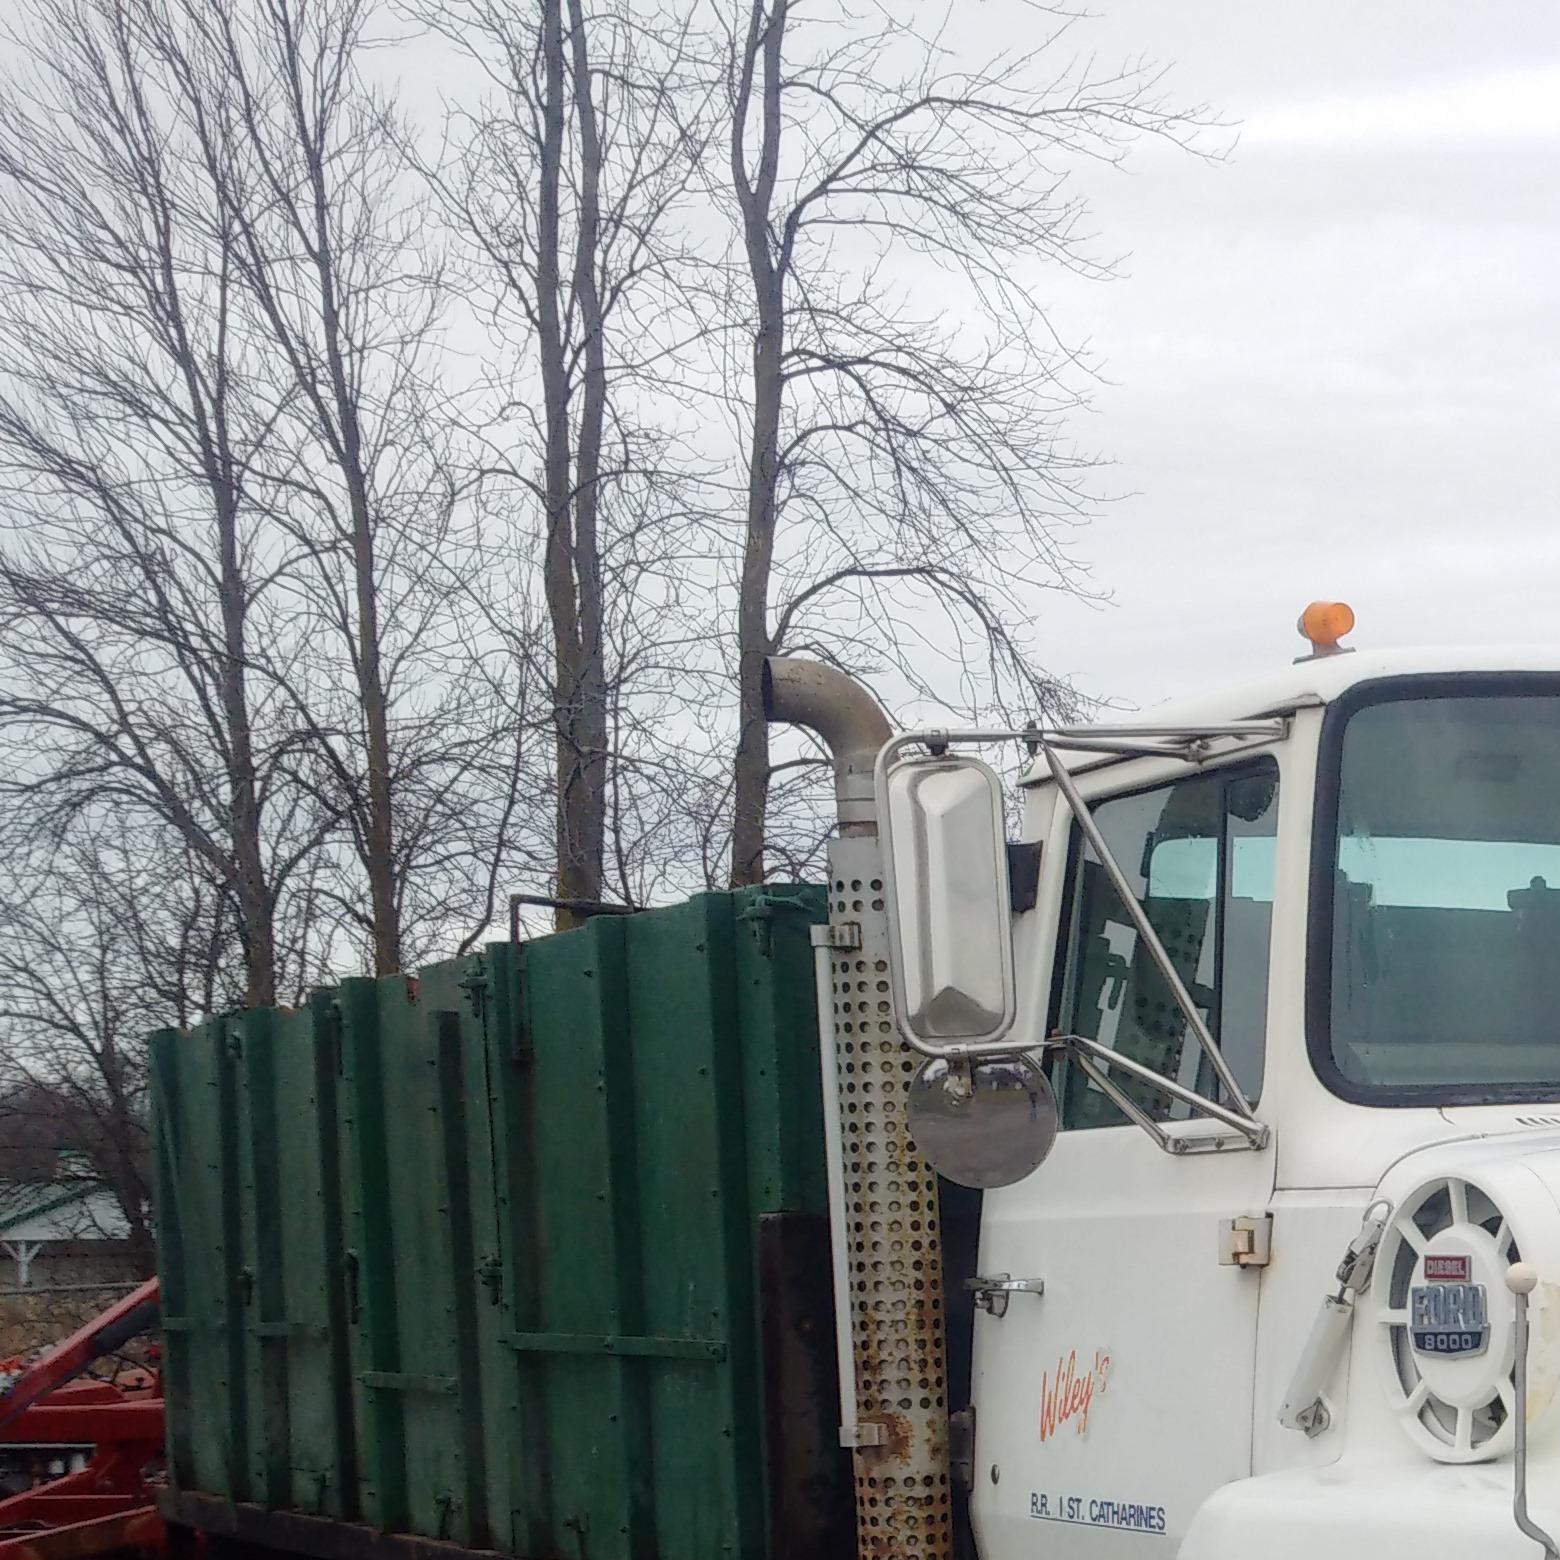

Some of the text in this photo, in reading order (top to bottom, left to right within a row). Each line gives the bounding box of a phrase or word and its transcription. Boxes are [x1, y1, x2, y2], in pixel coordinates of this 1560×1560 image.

[1426, 1258, 1465, 1276] DIESEL
[1413, 1285, 1486, 1330] FORD
[1424, 1334, 1472, 1350] 8000
[1041, 1350, 1110, 1441] Wiley's
[1066, 1496, 1085, 1521] ST.
[1089, 1498, 1166, 1531] CATHARINES
